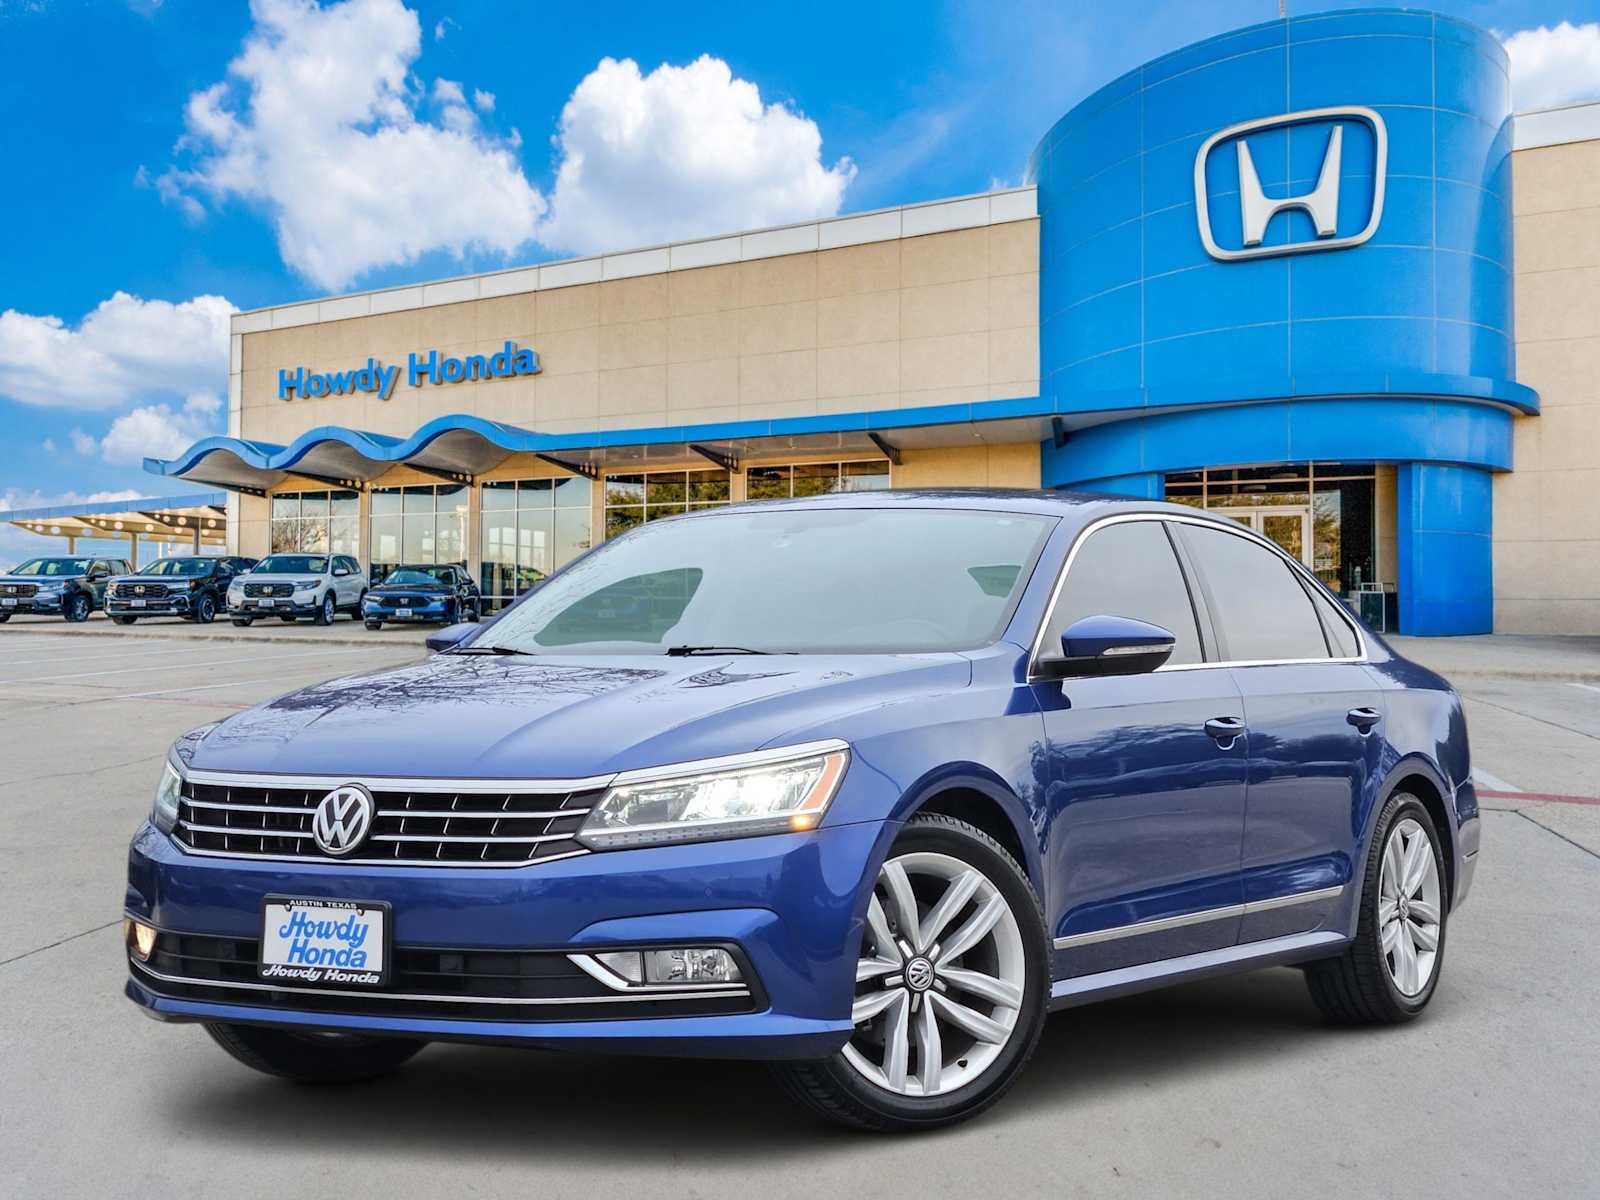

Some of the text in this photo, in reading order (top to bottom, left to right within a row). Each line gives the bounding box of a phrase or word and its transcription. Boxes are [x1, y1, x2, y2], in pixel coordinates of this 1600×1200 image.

[278, 340, 541, 401] Howdy Honda
[289, 899, 357, 909] AUSTIN TEXAS
[279, 911, 369, 948] Howdy
[287, 938, 368, 968] Honda
[262, 965, 380, 984] Howdy Honda
